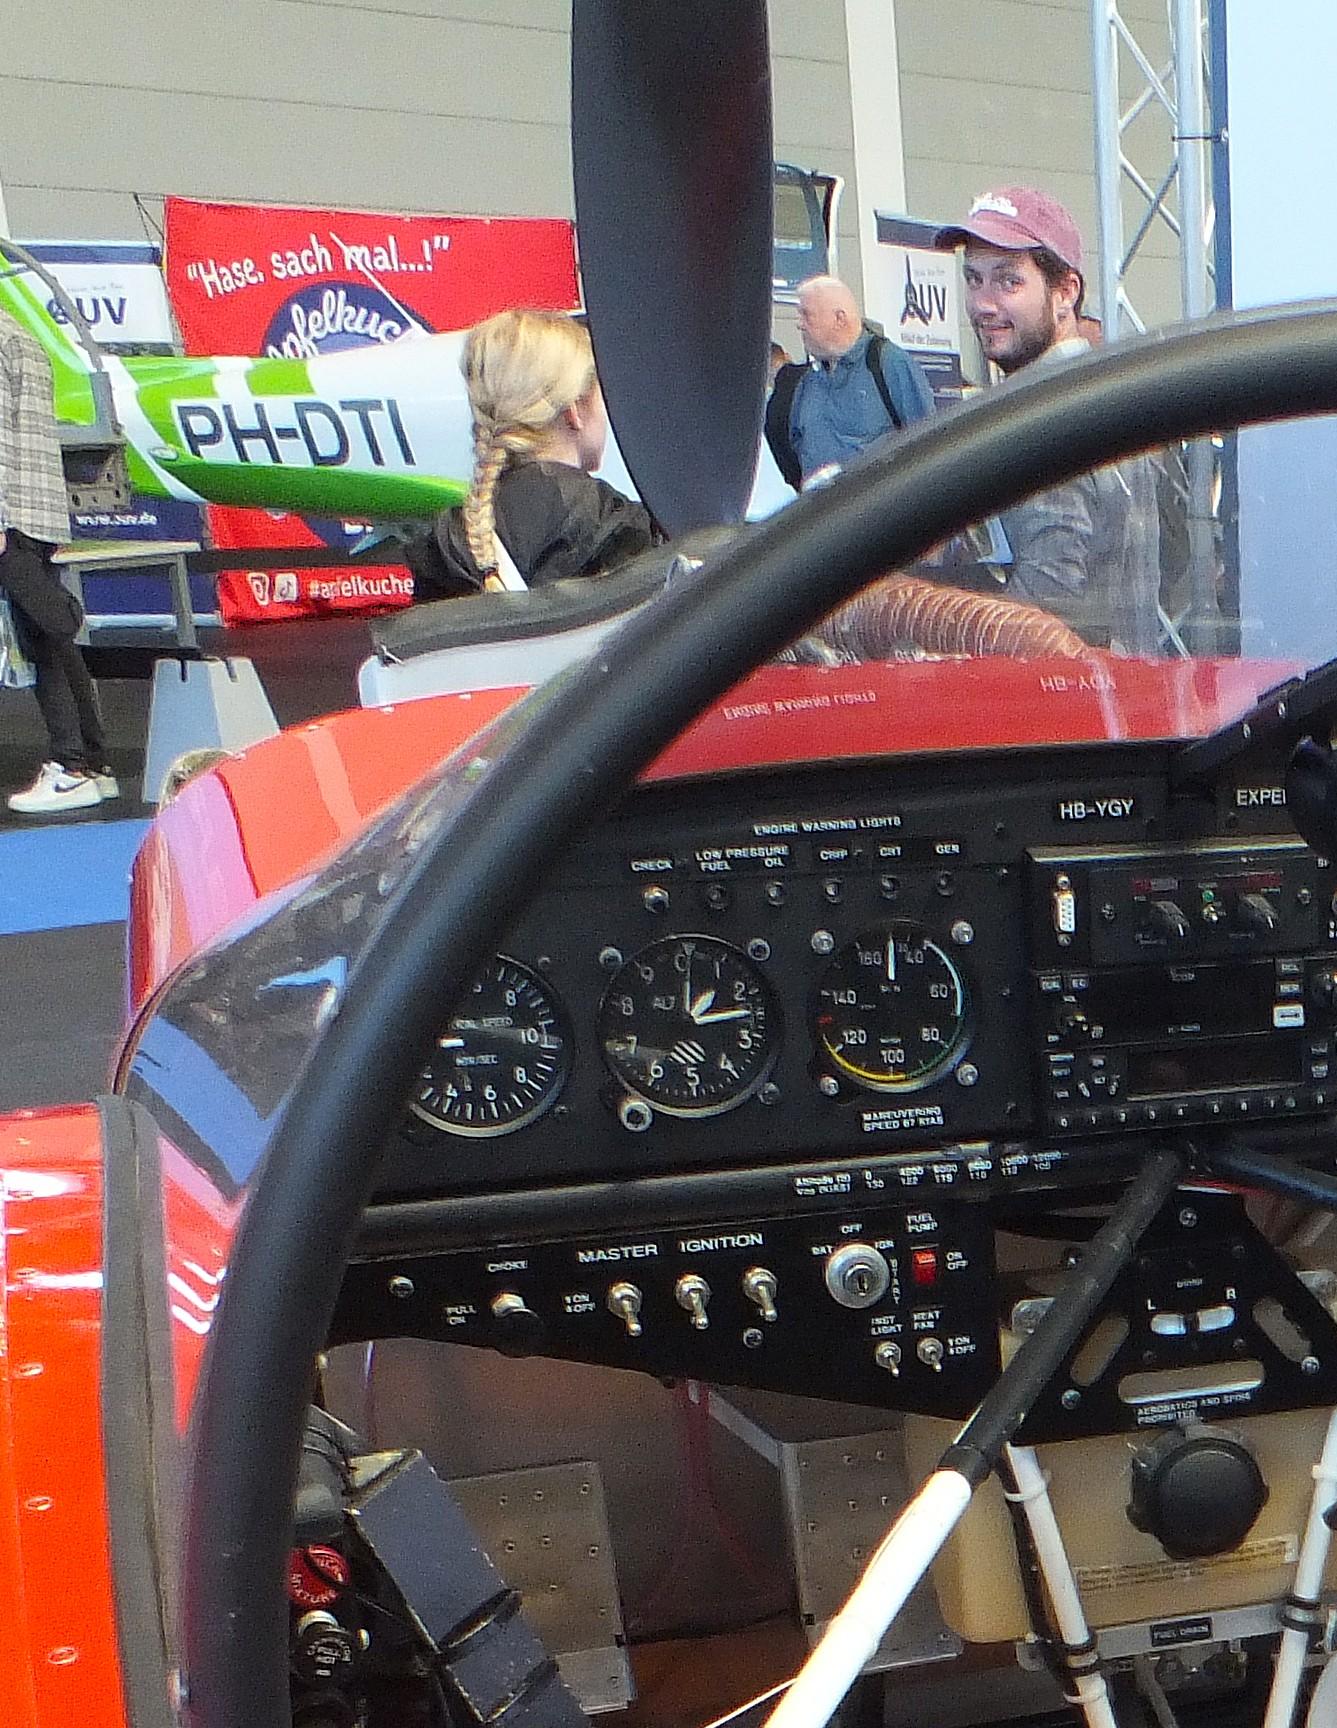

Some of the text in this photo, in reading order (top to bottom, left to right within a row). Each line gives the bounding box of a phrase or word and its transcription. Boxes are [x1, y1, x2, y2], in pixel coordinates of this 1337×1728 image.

[271, 233, 332, 278] sach
[175, 400, 417, 466] PH-DTI
[1060, 799, 1134, 819] HB-YGY
[802, 819, 856, 833] WARNING
[696, 845, 789, 861] LOW PRESSURE
[734, 981, 746, 1001] 2
[521, 1028, 539, 1045] 10
[738, 1029, 753, 1050] 3
[842, 1029, 867, 1045] 120
[880, 1048, 905, 1064] 100
[686, 1067, 700, 1086] 5
[484, 1084, 497, 1101] 6
[680, 1233, 764, 1254] IGNITION
[578, 1243, 659, 1263] MASTER
[1226, 1287, 1236, 1300] R
[1147, 1299, 1156, 1310] L
